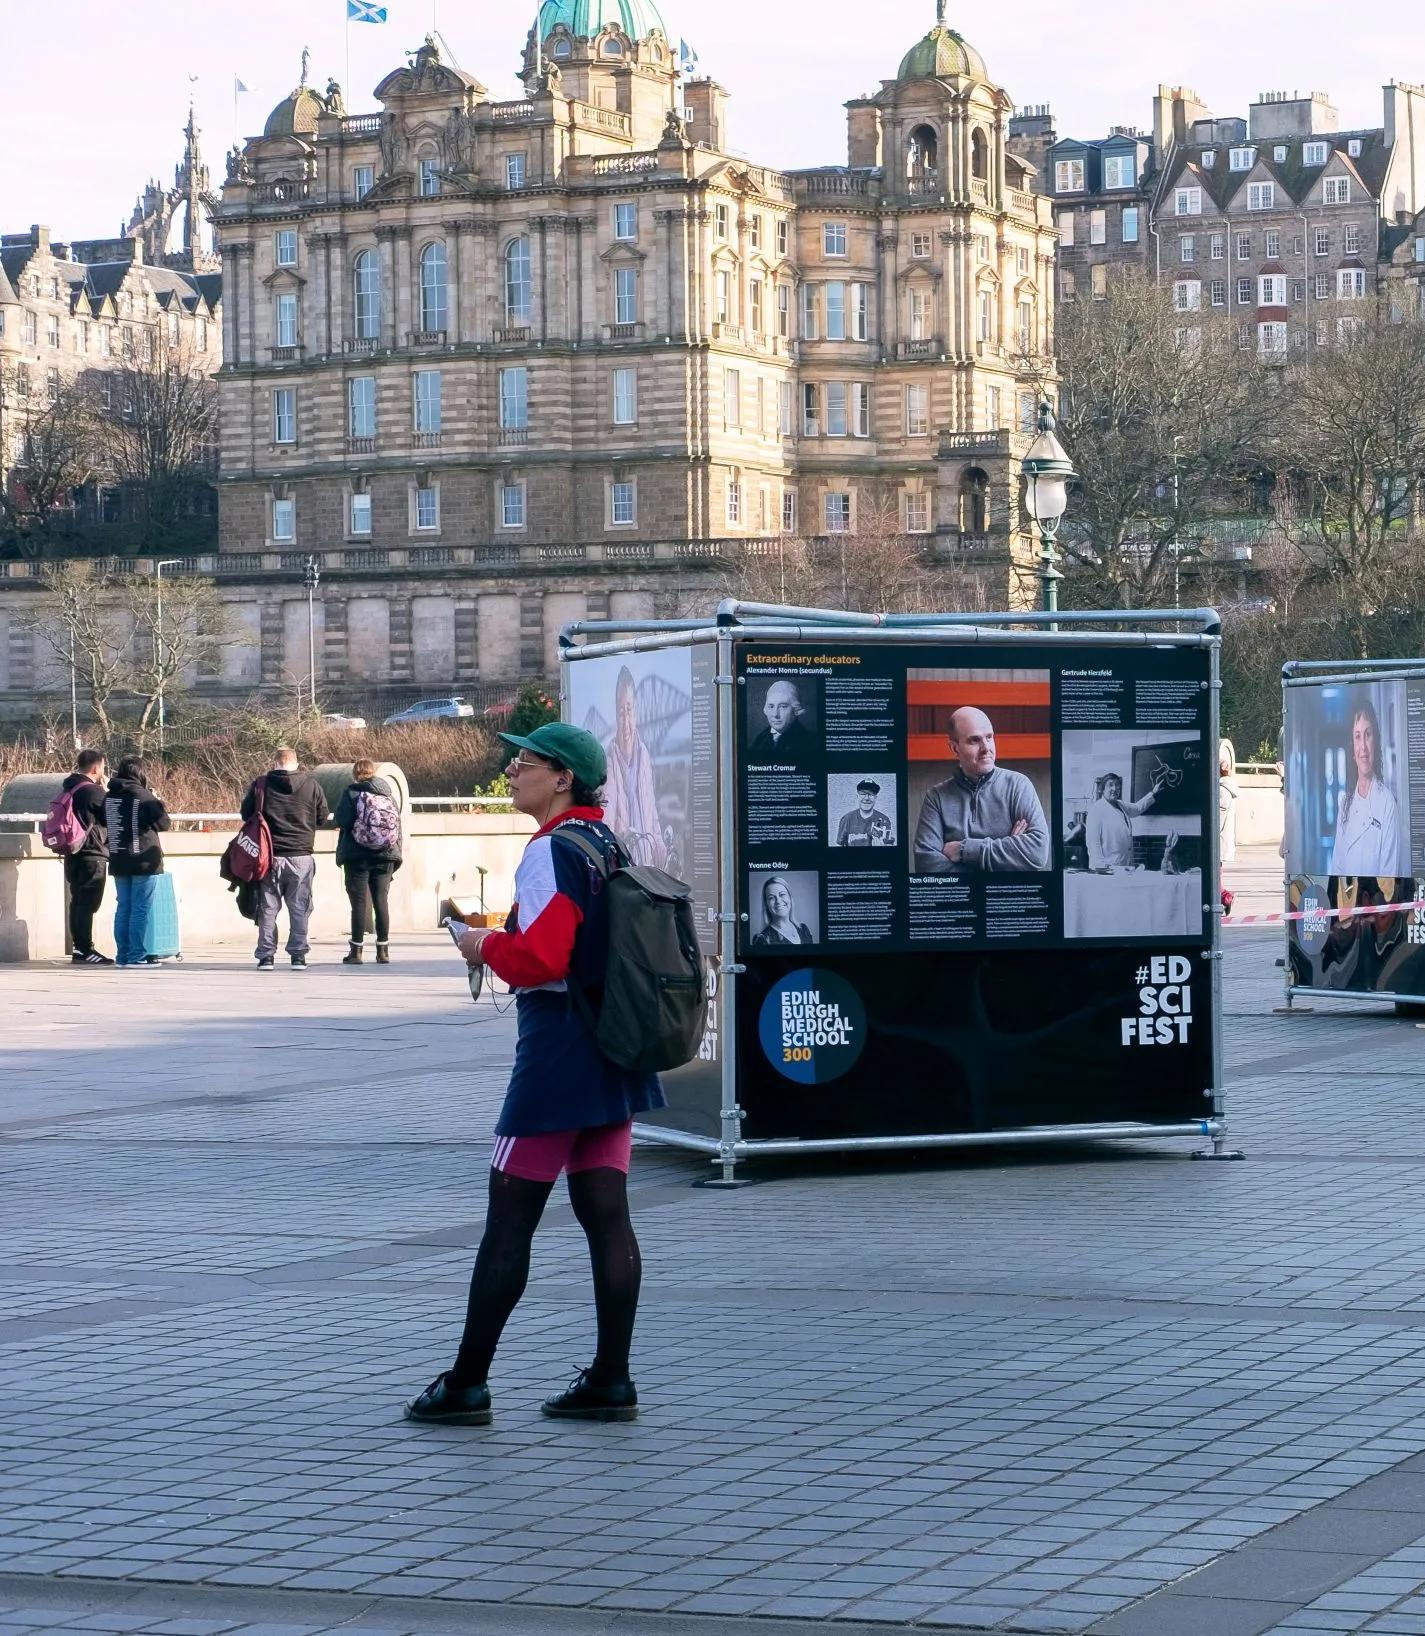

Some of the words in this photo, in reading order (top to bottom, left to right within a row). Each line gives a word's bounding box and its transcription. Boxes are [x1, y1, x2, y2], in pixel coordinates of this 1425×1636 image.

[747, 654, 812, 665] Extraordinary
[814, 655, 861, 664] educators
[799, 667, 832, 675] (secundus)
[238, 831, 260, 857] VANS
[923, 876, 959, 884] Gillingwater
[1304, 924, 1325, 932] SCHOOL
[1135, 955, 1191, 984] #ED
[781, 990, 820, 1006] EDIN
[1139, 985, 1191, 1015] SCI
[707, 1000, 717, 1029] CI
[781, 1004, 839, 1020] BURGH
[781, 1017, 853, 1034] MEDICAL
[1121, 1016, 1192, 1046] FEST
[782, 1030, 849, 1047] SCHOOL
[782, 1047, 812, 1062] 300
